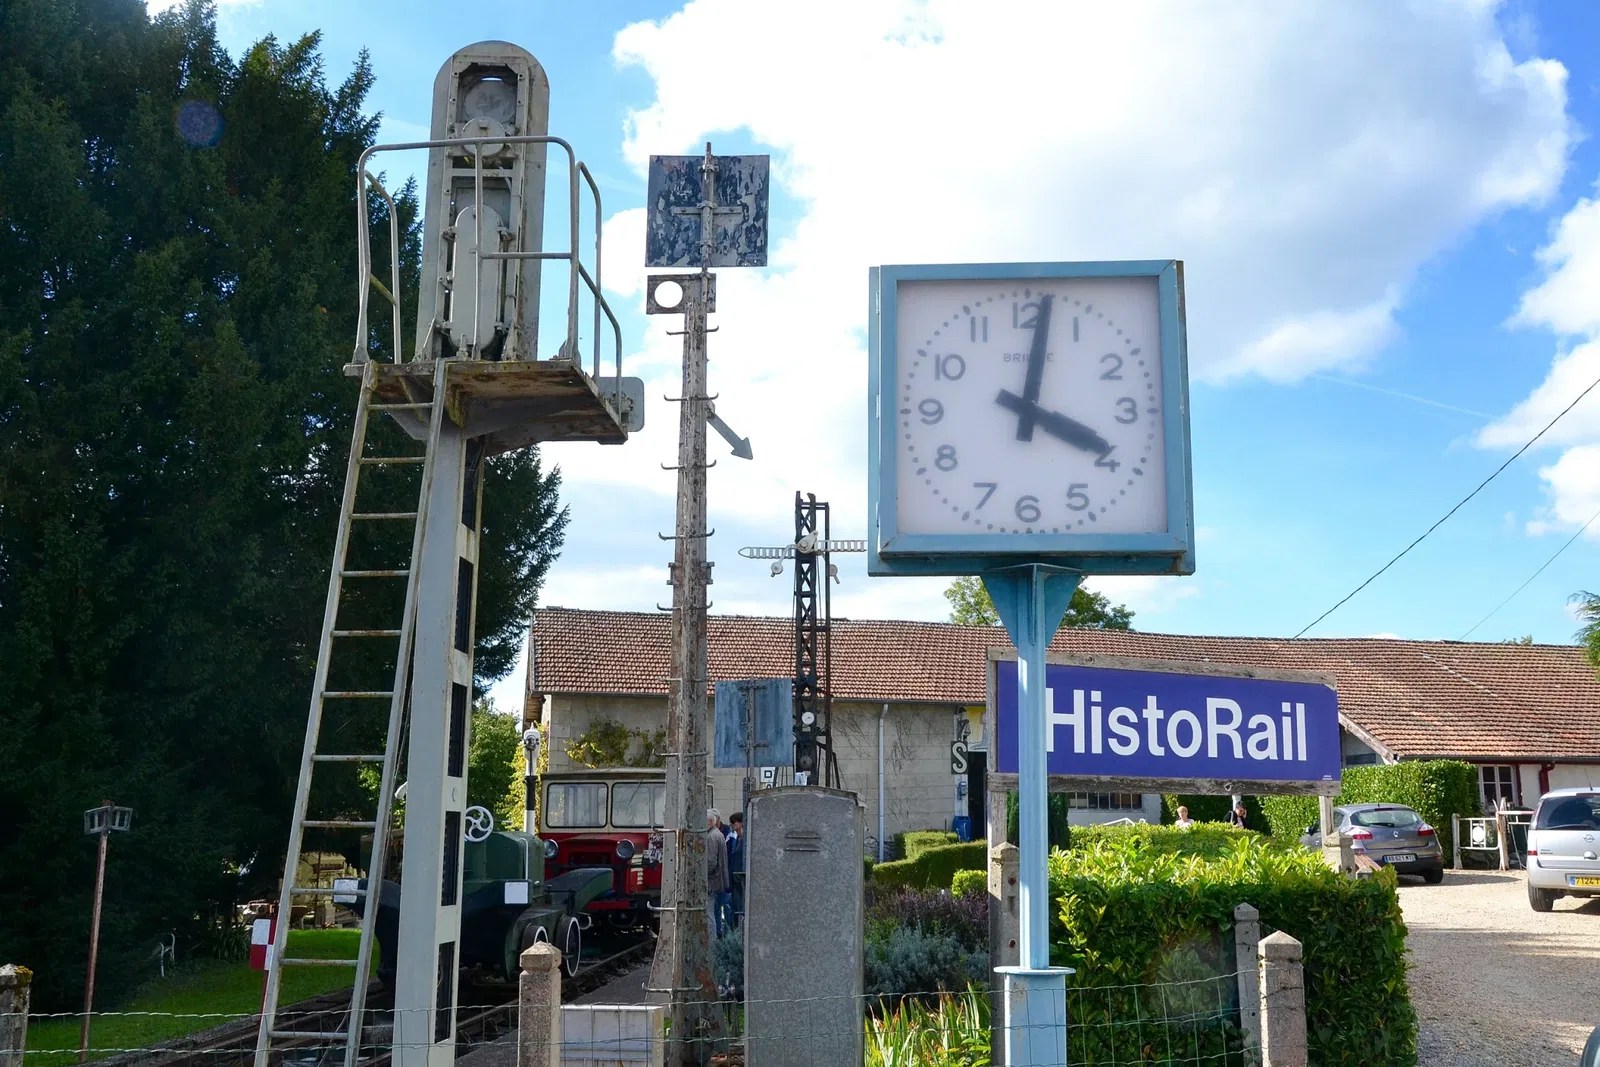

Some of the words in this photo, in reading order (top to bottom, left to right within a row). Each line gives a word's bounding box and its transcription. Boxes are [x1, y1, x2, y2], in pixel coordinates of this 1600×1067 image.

[970, 316, 988, 342] 11
[1012, 302, 1043, 329] 12
[1073, 316, 1079, 342] 1
[934, 353, 966, 381] 10
[1099, 353, 1123, 380] 2
[917, 398, 944, 425] 9
[1114, 397, 1138, 424] 3
[934, 444, 958, 472] 8
[1094, 445, 1120, 472] 4
[973, 482, 998, 510] 7
[1014, 495, 1041, 523] 6
[1065, 483, 1090, 511] 5
[1046, 687, 1307, 761] HistoRail
[952, 742, 967, 773] S
